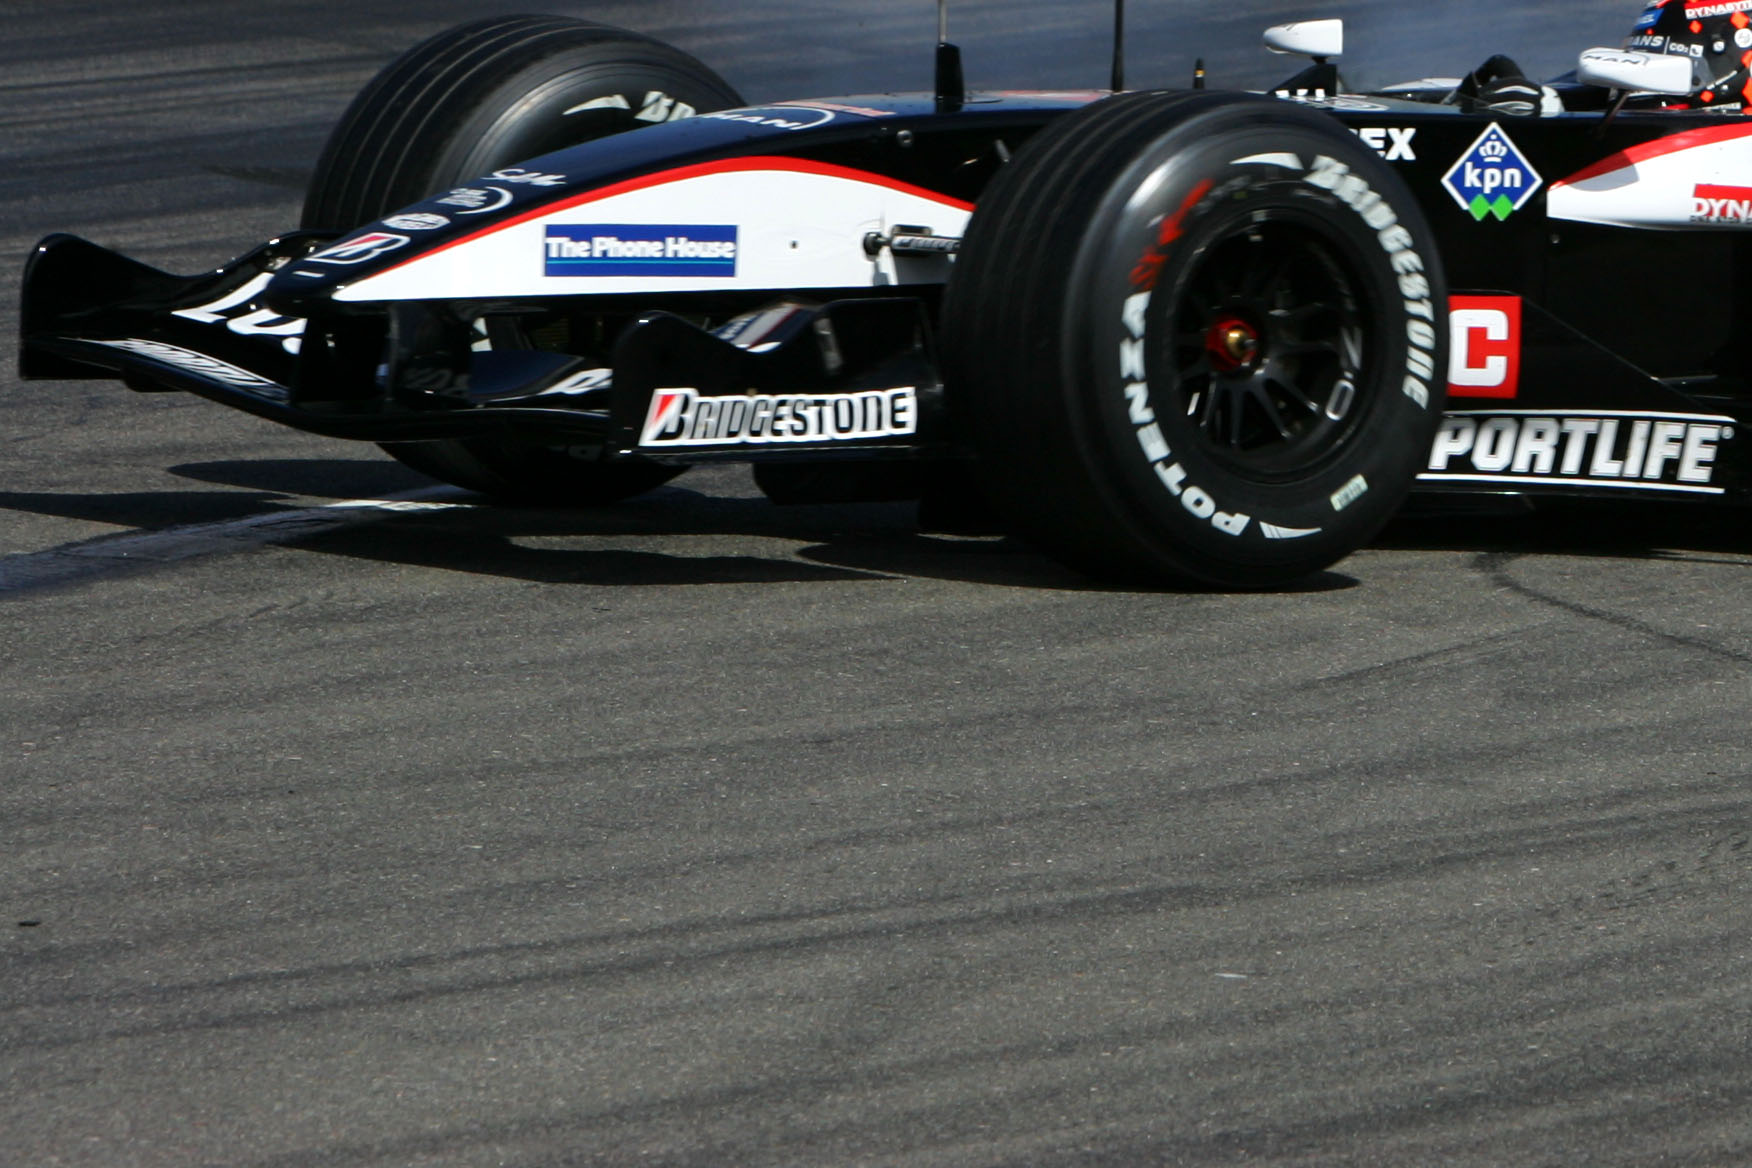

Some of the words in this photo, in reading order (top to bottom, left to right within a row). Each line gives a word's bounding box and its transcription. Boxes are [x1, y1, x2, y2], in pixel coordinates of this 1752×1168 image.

[1349, 128, 1416, 160] EX
[1464, 161, 1522, 194] kpn
[545, 236, 591, 258] The
[592, 236, 665, 258] Phone
[665, 236, 736, 258] House
[1448, 309, 1508, 386] C
[639, 387, 917, 446] BRIDGESTONE
[1428, 417, 1721, 482] PORTLIFE
